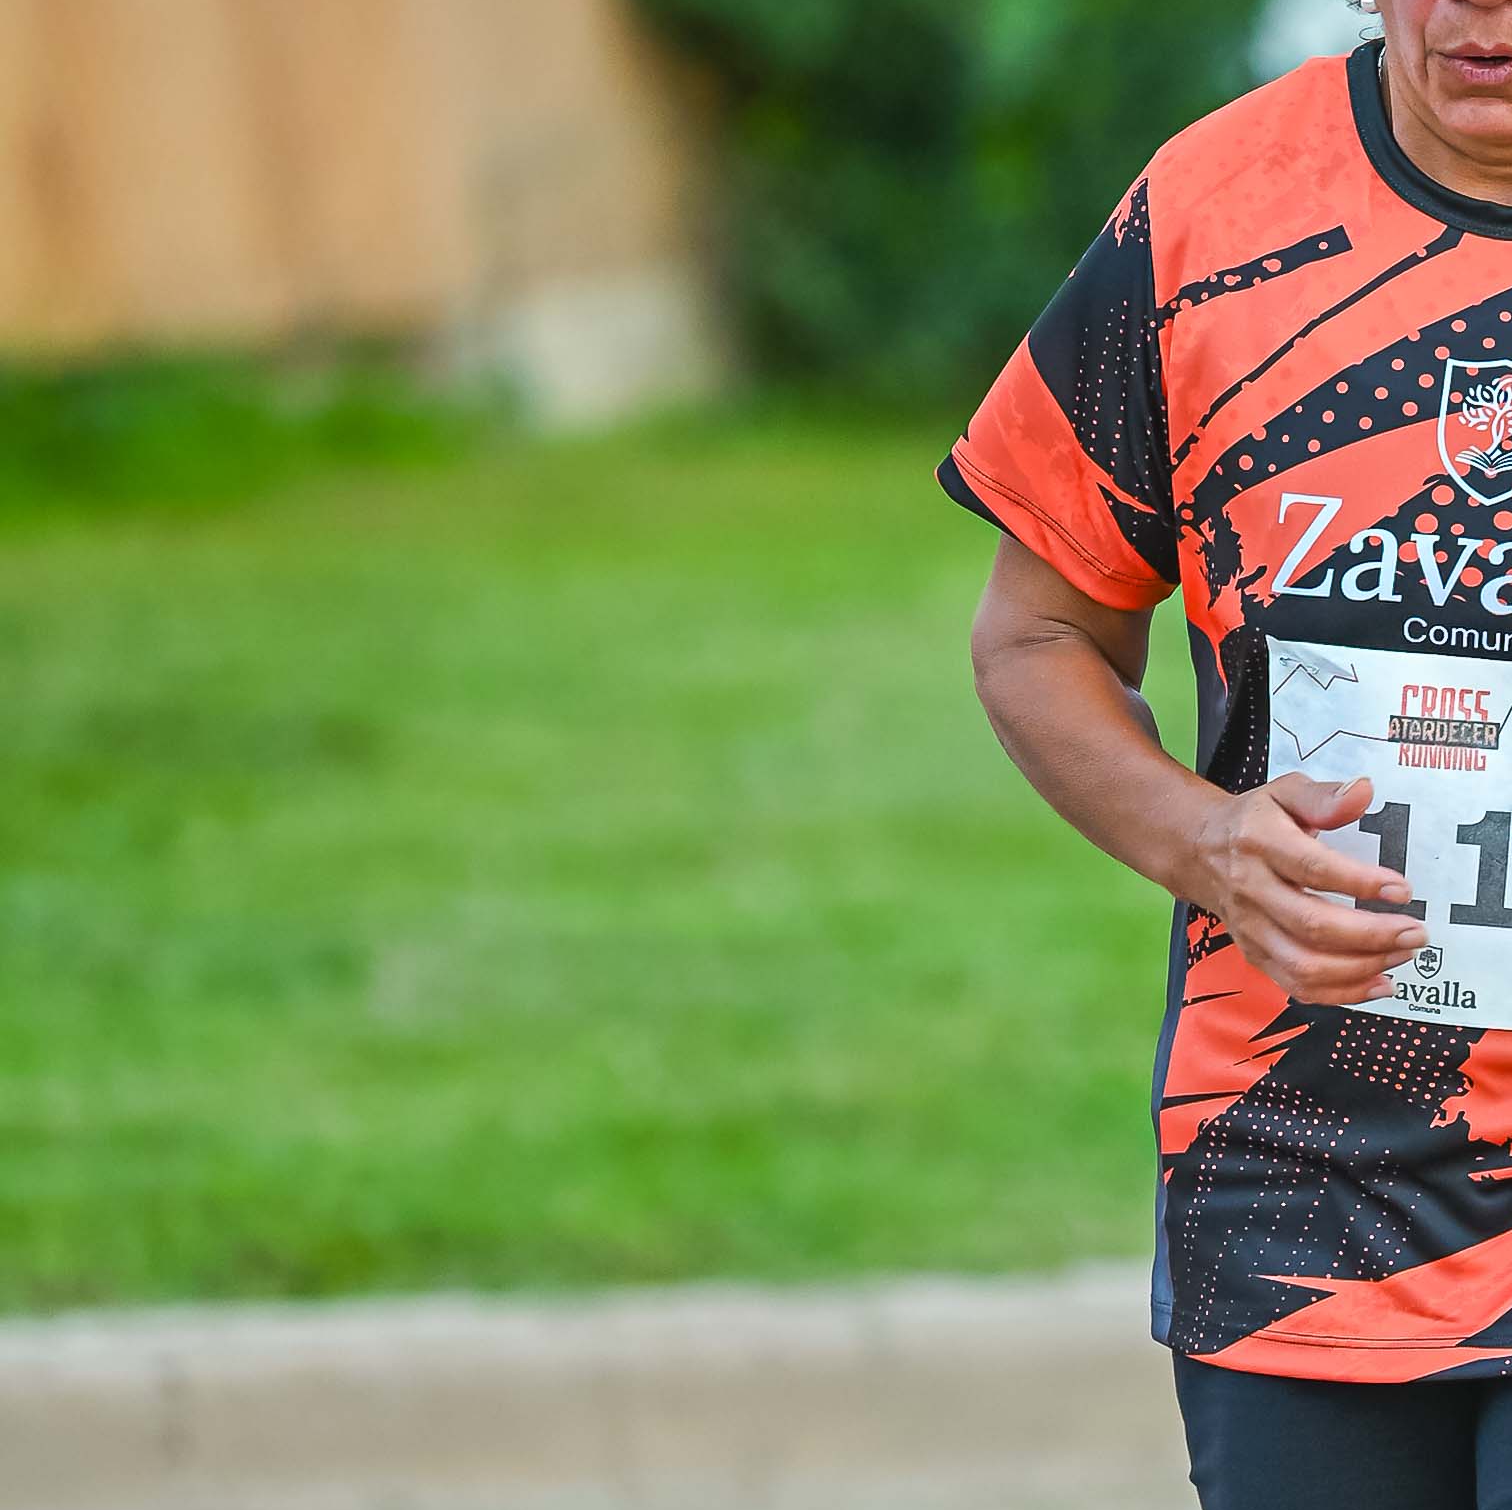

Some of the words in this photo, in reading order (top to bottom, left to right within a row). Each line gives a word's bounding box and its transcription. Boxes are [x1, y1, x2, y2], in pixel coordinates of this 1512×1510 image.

[1401, 684, 1491, 722] CROSS
[1388, 717, 1498, 748] ATARDECER
[1382, 973, 1477, 1009] avalla
[1408, 1003, 1441, 1015] Comuna
